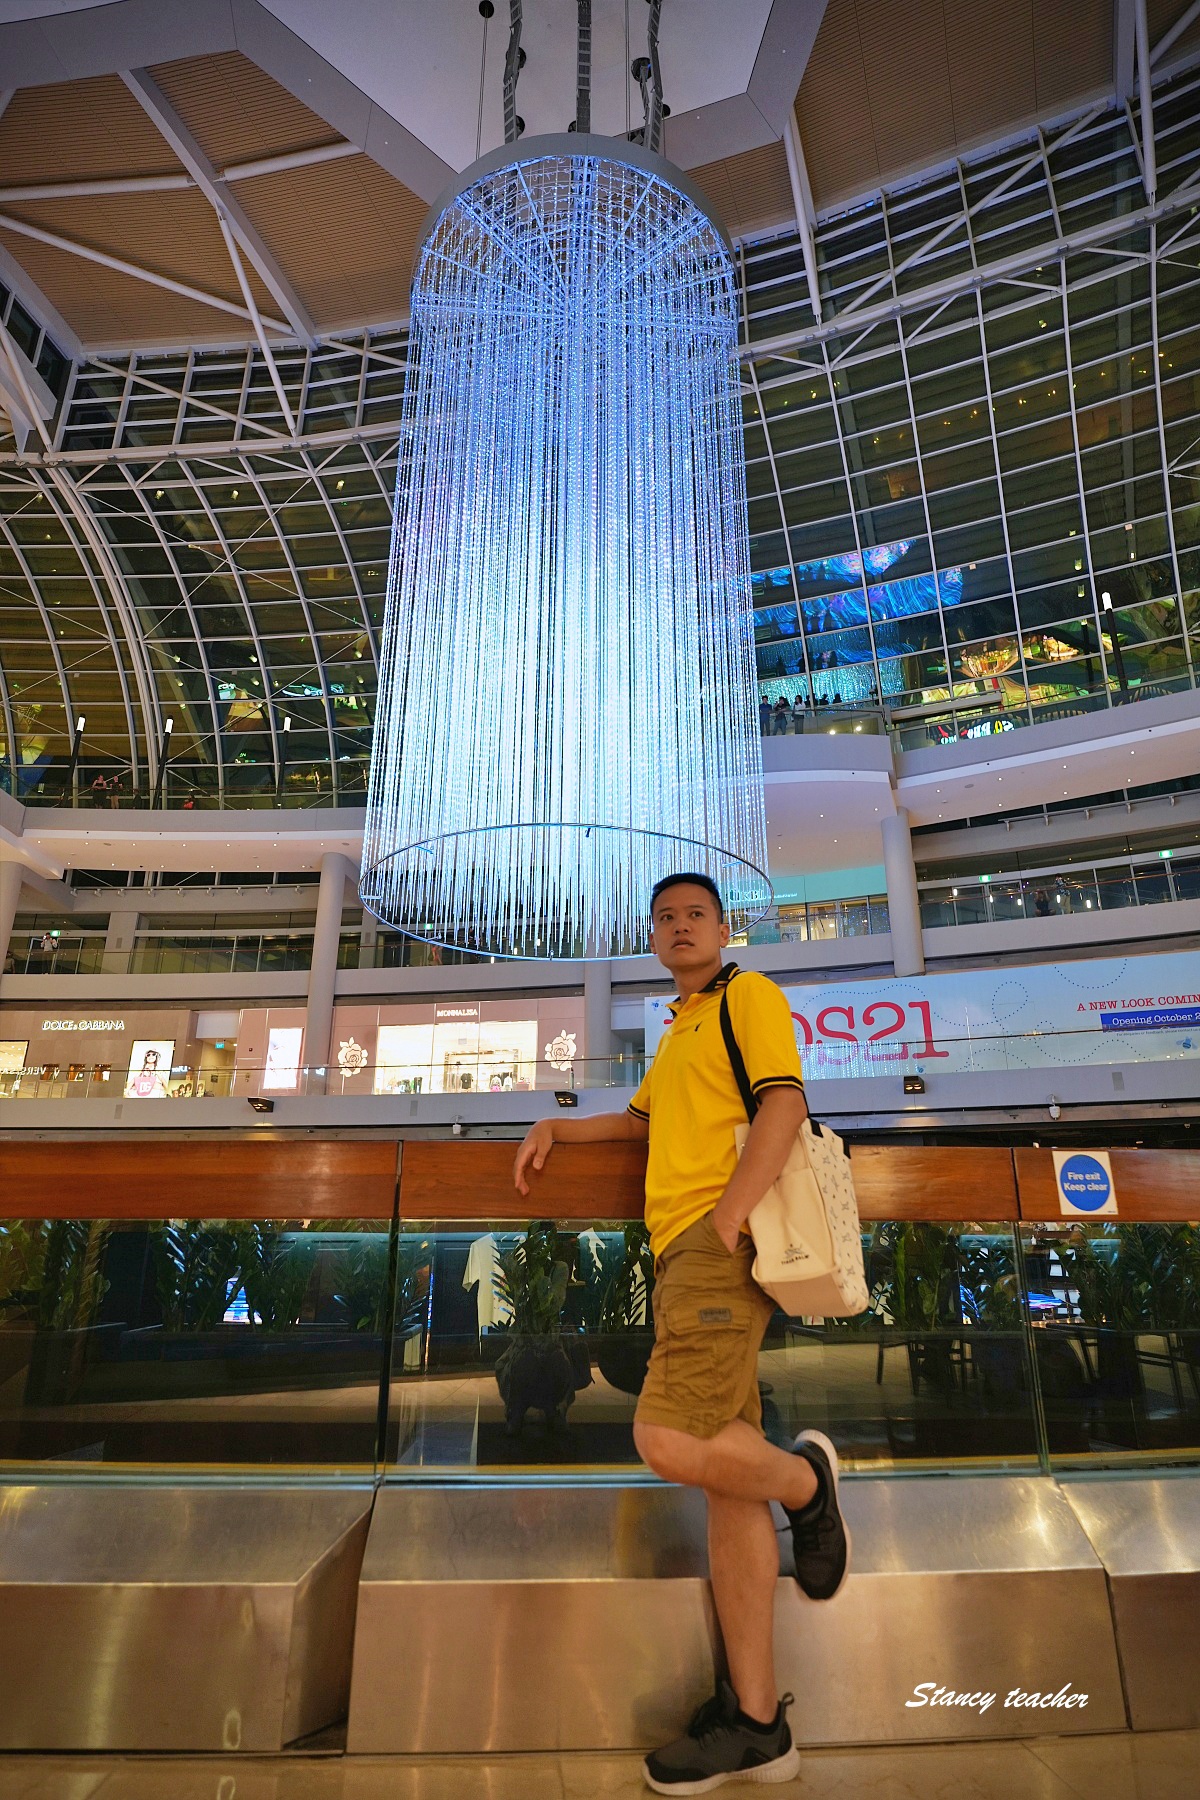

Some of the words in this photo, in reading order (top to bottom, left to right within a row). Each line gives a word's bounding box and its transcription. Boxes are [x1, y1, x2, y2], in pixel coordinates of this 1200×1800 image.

[1077, 1003, 1086, 1012] A
[1089, 1000, 1118, 1010] NEW
[1121, 998, 1155, 1008] LOOK
[1112, 1016, 1153, 1026] Opening
[1154, 1013, 1193, 1022] October
[1067, 1172, 1084, 1180] Fire
[1085, 1172, 1101, 1180] exit
[1064, 1183, 1086, 1192] Keep
